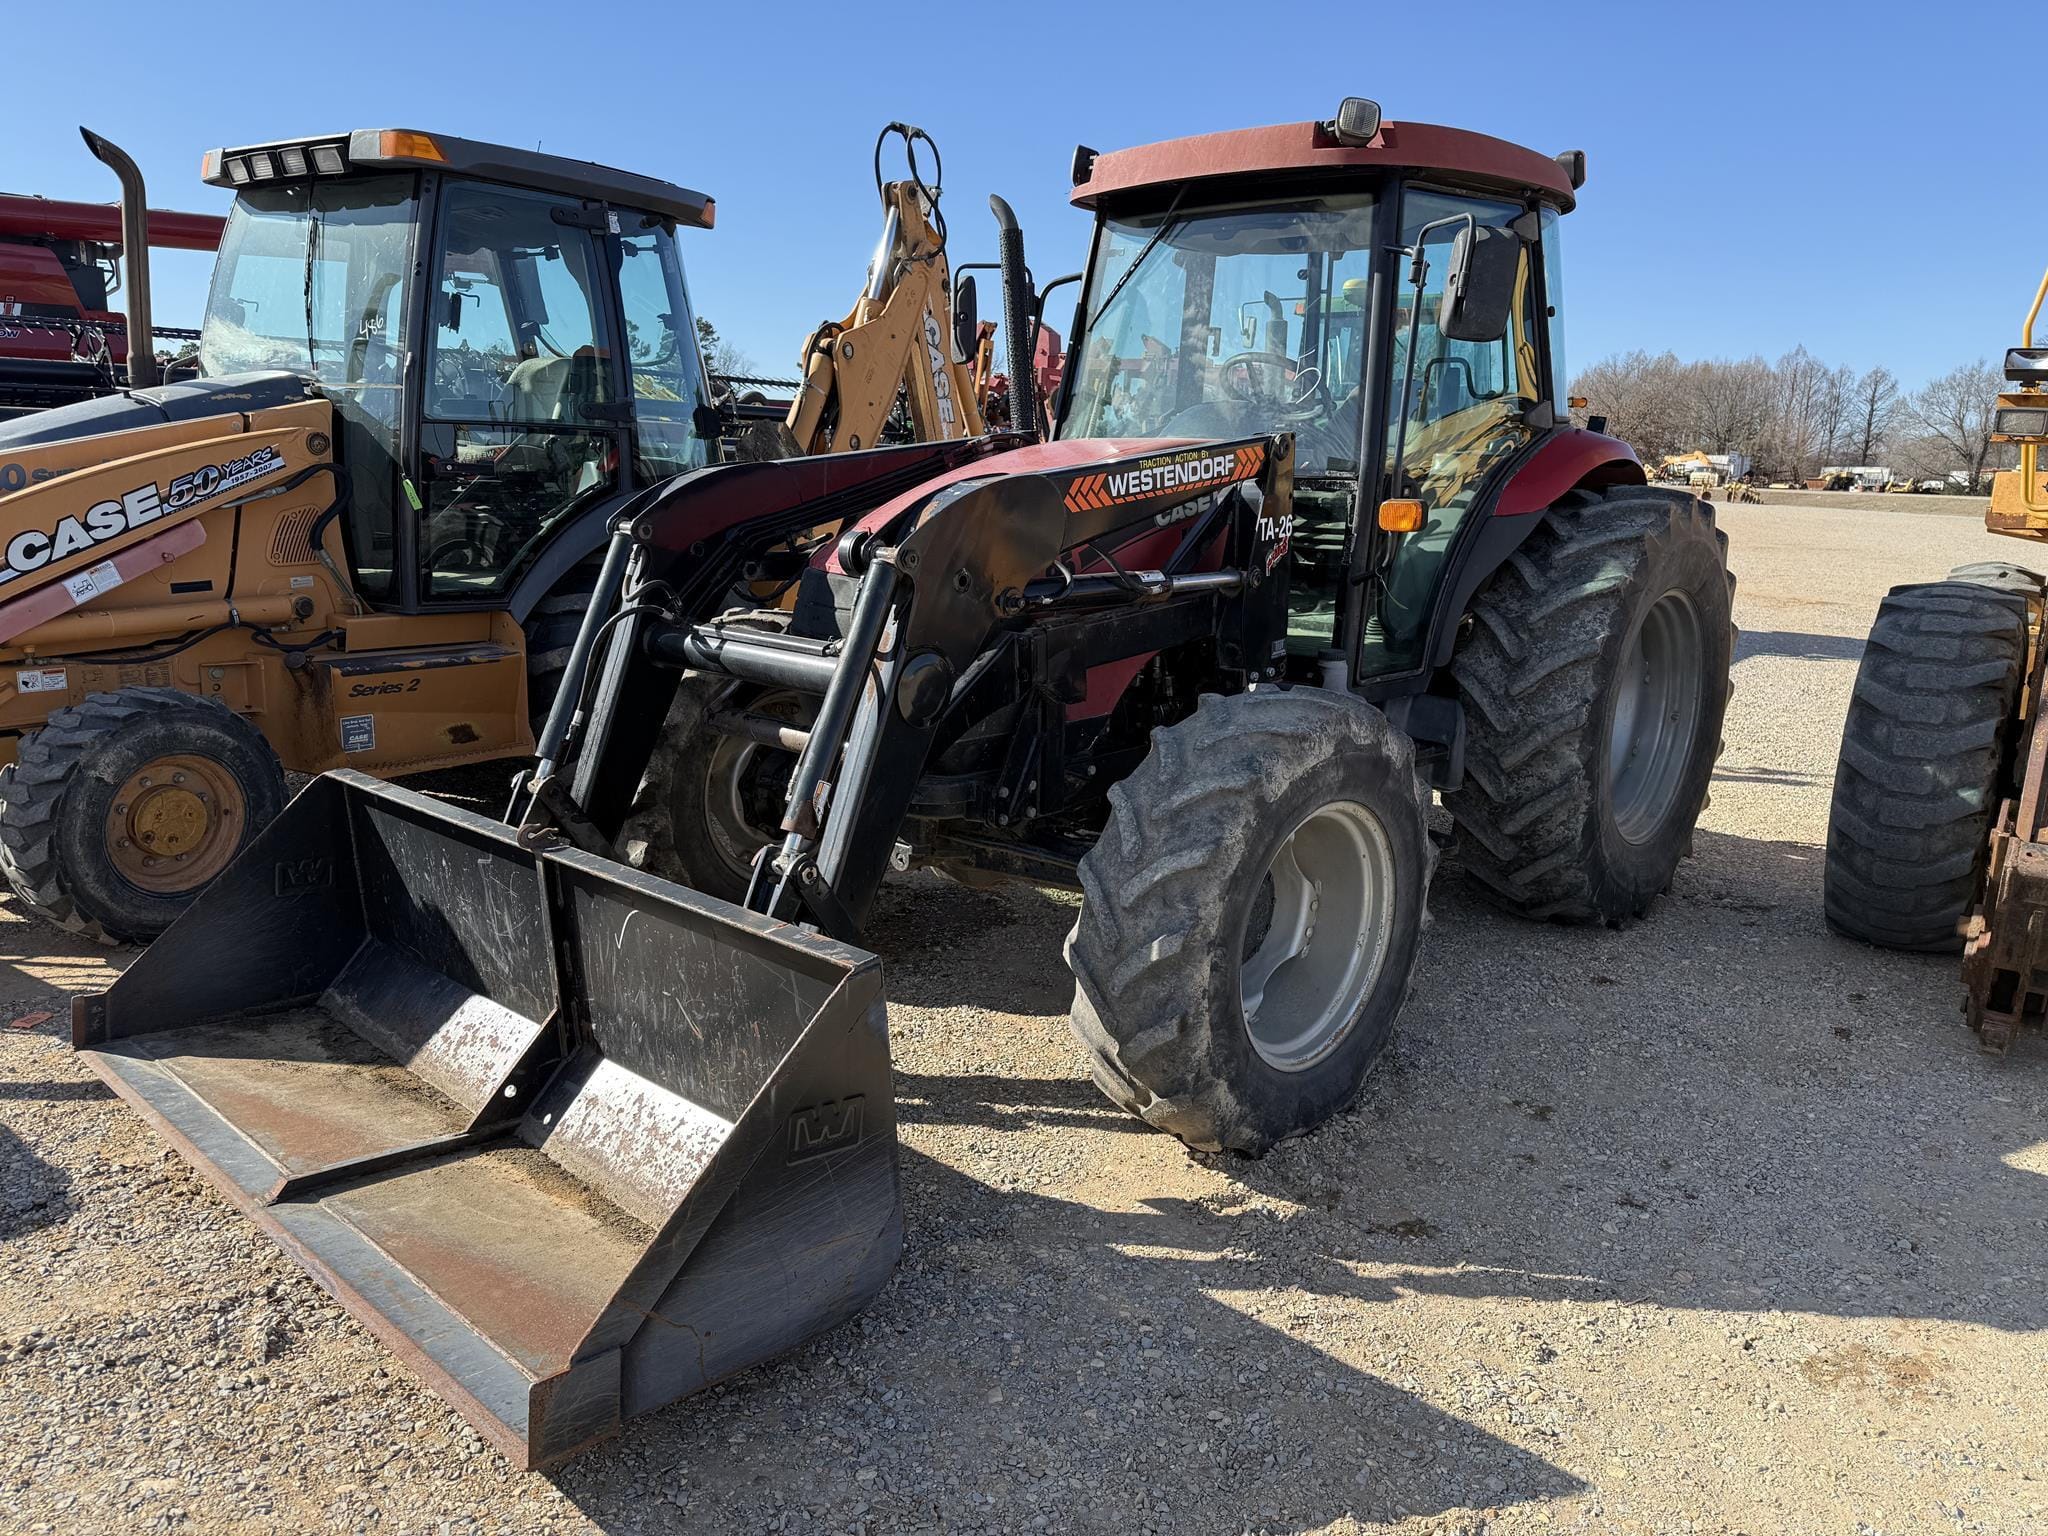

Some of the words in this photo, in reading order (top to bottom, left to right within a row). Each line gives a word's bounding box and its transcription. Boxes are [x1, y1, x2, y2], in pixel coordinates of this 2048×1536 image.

[360, 314, 384, 340] 486
[924, 316, 956, 423] CASE
[230, 461, 274, 485] 1957-2007
[1108, 454, 1235, 497] WESTENDORF
[1138, 457, 1172, 470] TRACTION
[1174, 451, 1199, 464] ACTION
[168, 464, 221, 507] 50
[222, 446, 273, 481] YEARS
[6, 481, 164, 572] CASE
[1154, 495, 1212, 528] CASE
[1259, 513, 1293, 542] TA-26
[348, 681, 404, 698] Series
[406, 678, 421, 692] 2
